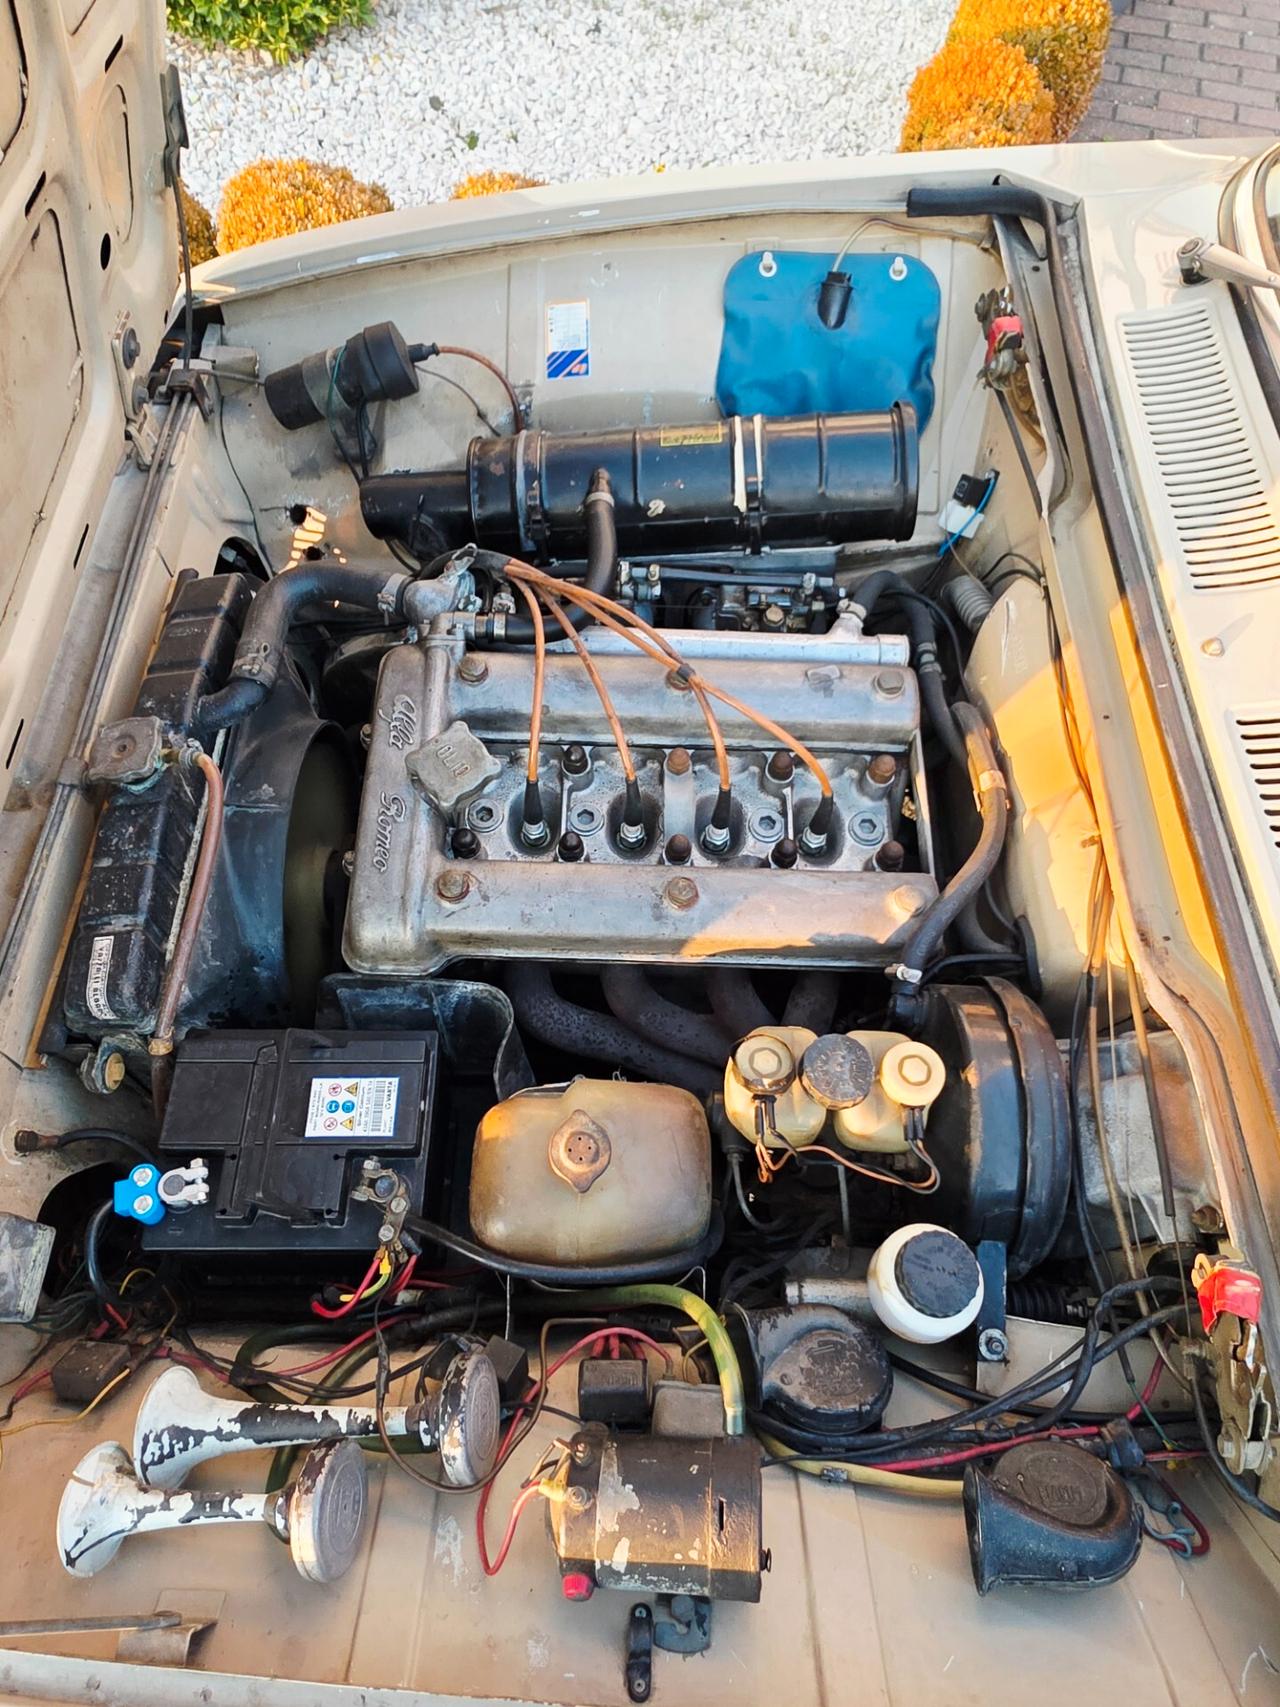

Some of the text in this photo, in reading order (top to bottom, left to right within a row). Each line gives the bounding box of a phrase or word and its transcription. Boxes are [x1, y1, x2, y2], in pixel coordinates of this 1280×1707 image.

[372, 694, 417, 874] Alfa Romeo
[436, 745, 472, 780] OLIO
